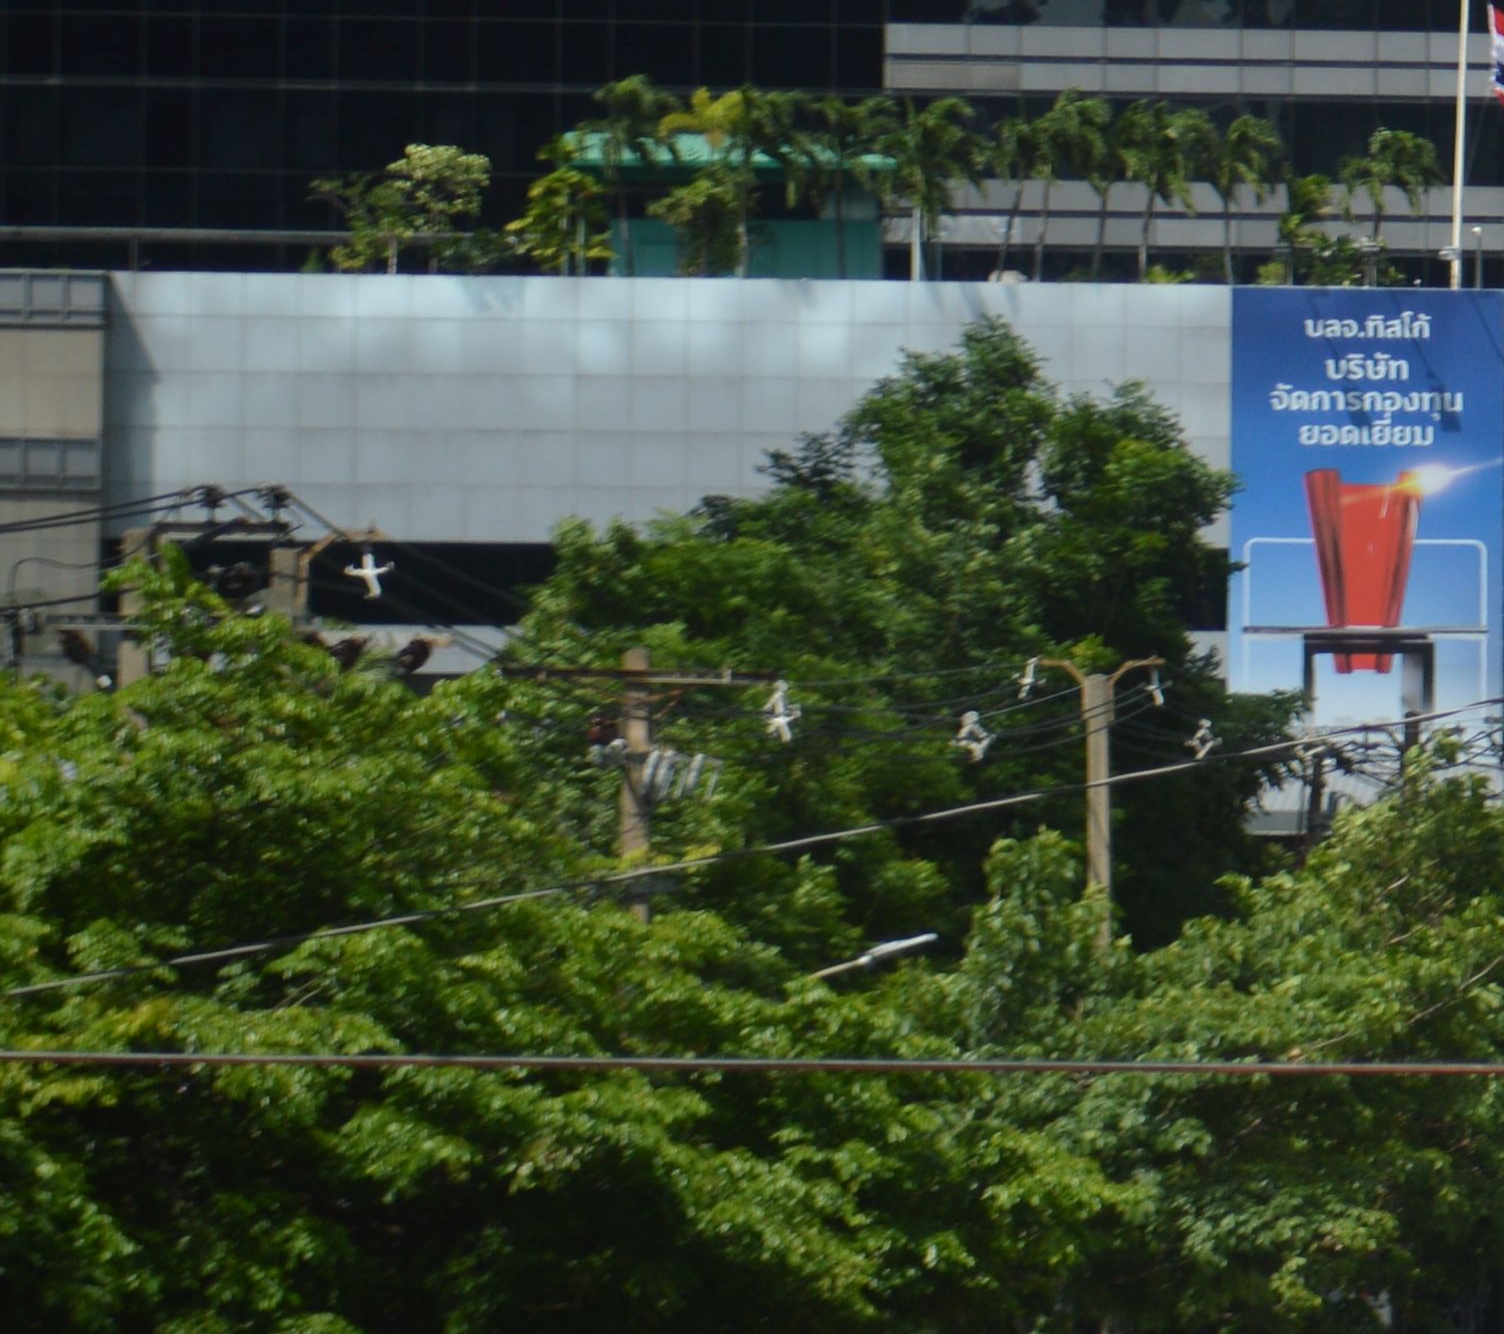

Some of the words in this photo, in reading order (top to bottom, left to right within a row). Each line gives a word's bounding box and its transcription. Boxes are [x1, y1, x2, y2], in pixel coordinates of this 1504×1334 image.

[1304, 311, 1432, 339] บลจ.ทิสโก้
[1324, 353, 1410, 381] บริษัท
[1269, 383, 1464, 420] จัดการกองทุน
[1298, 413, 1435, 446] ยอดเยี่ยม
